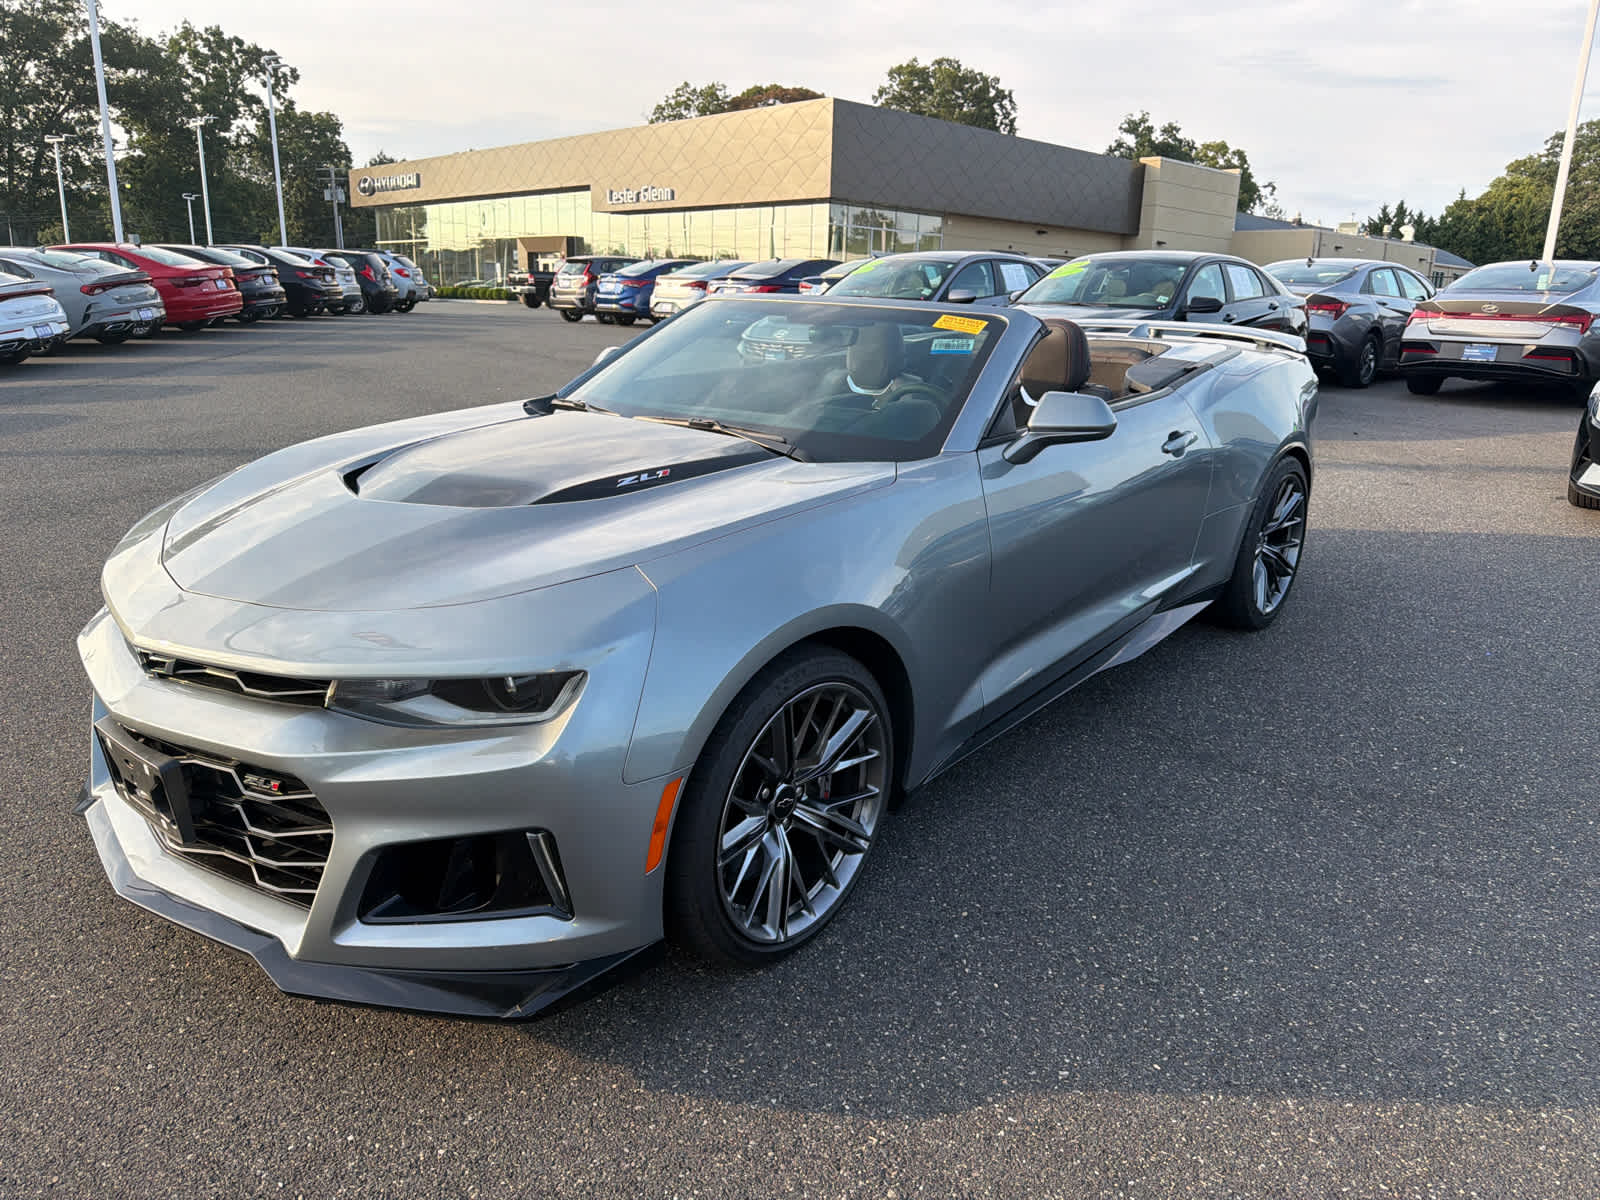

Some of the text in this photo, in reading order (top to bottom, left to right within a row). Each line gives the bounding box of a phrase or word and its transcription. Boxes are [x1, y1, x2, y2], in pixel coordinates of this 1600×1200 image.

[375, 172, 419, 191] HYUNDAI
[607, 185, 674, 204] Lester Glenn
[616, 469, 670, 488] ZL1
[243, 774, 281, 791] ZL1
